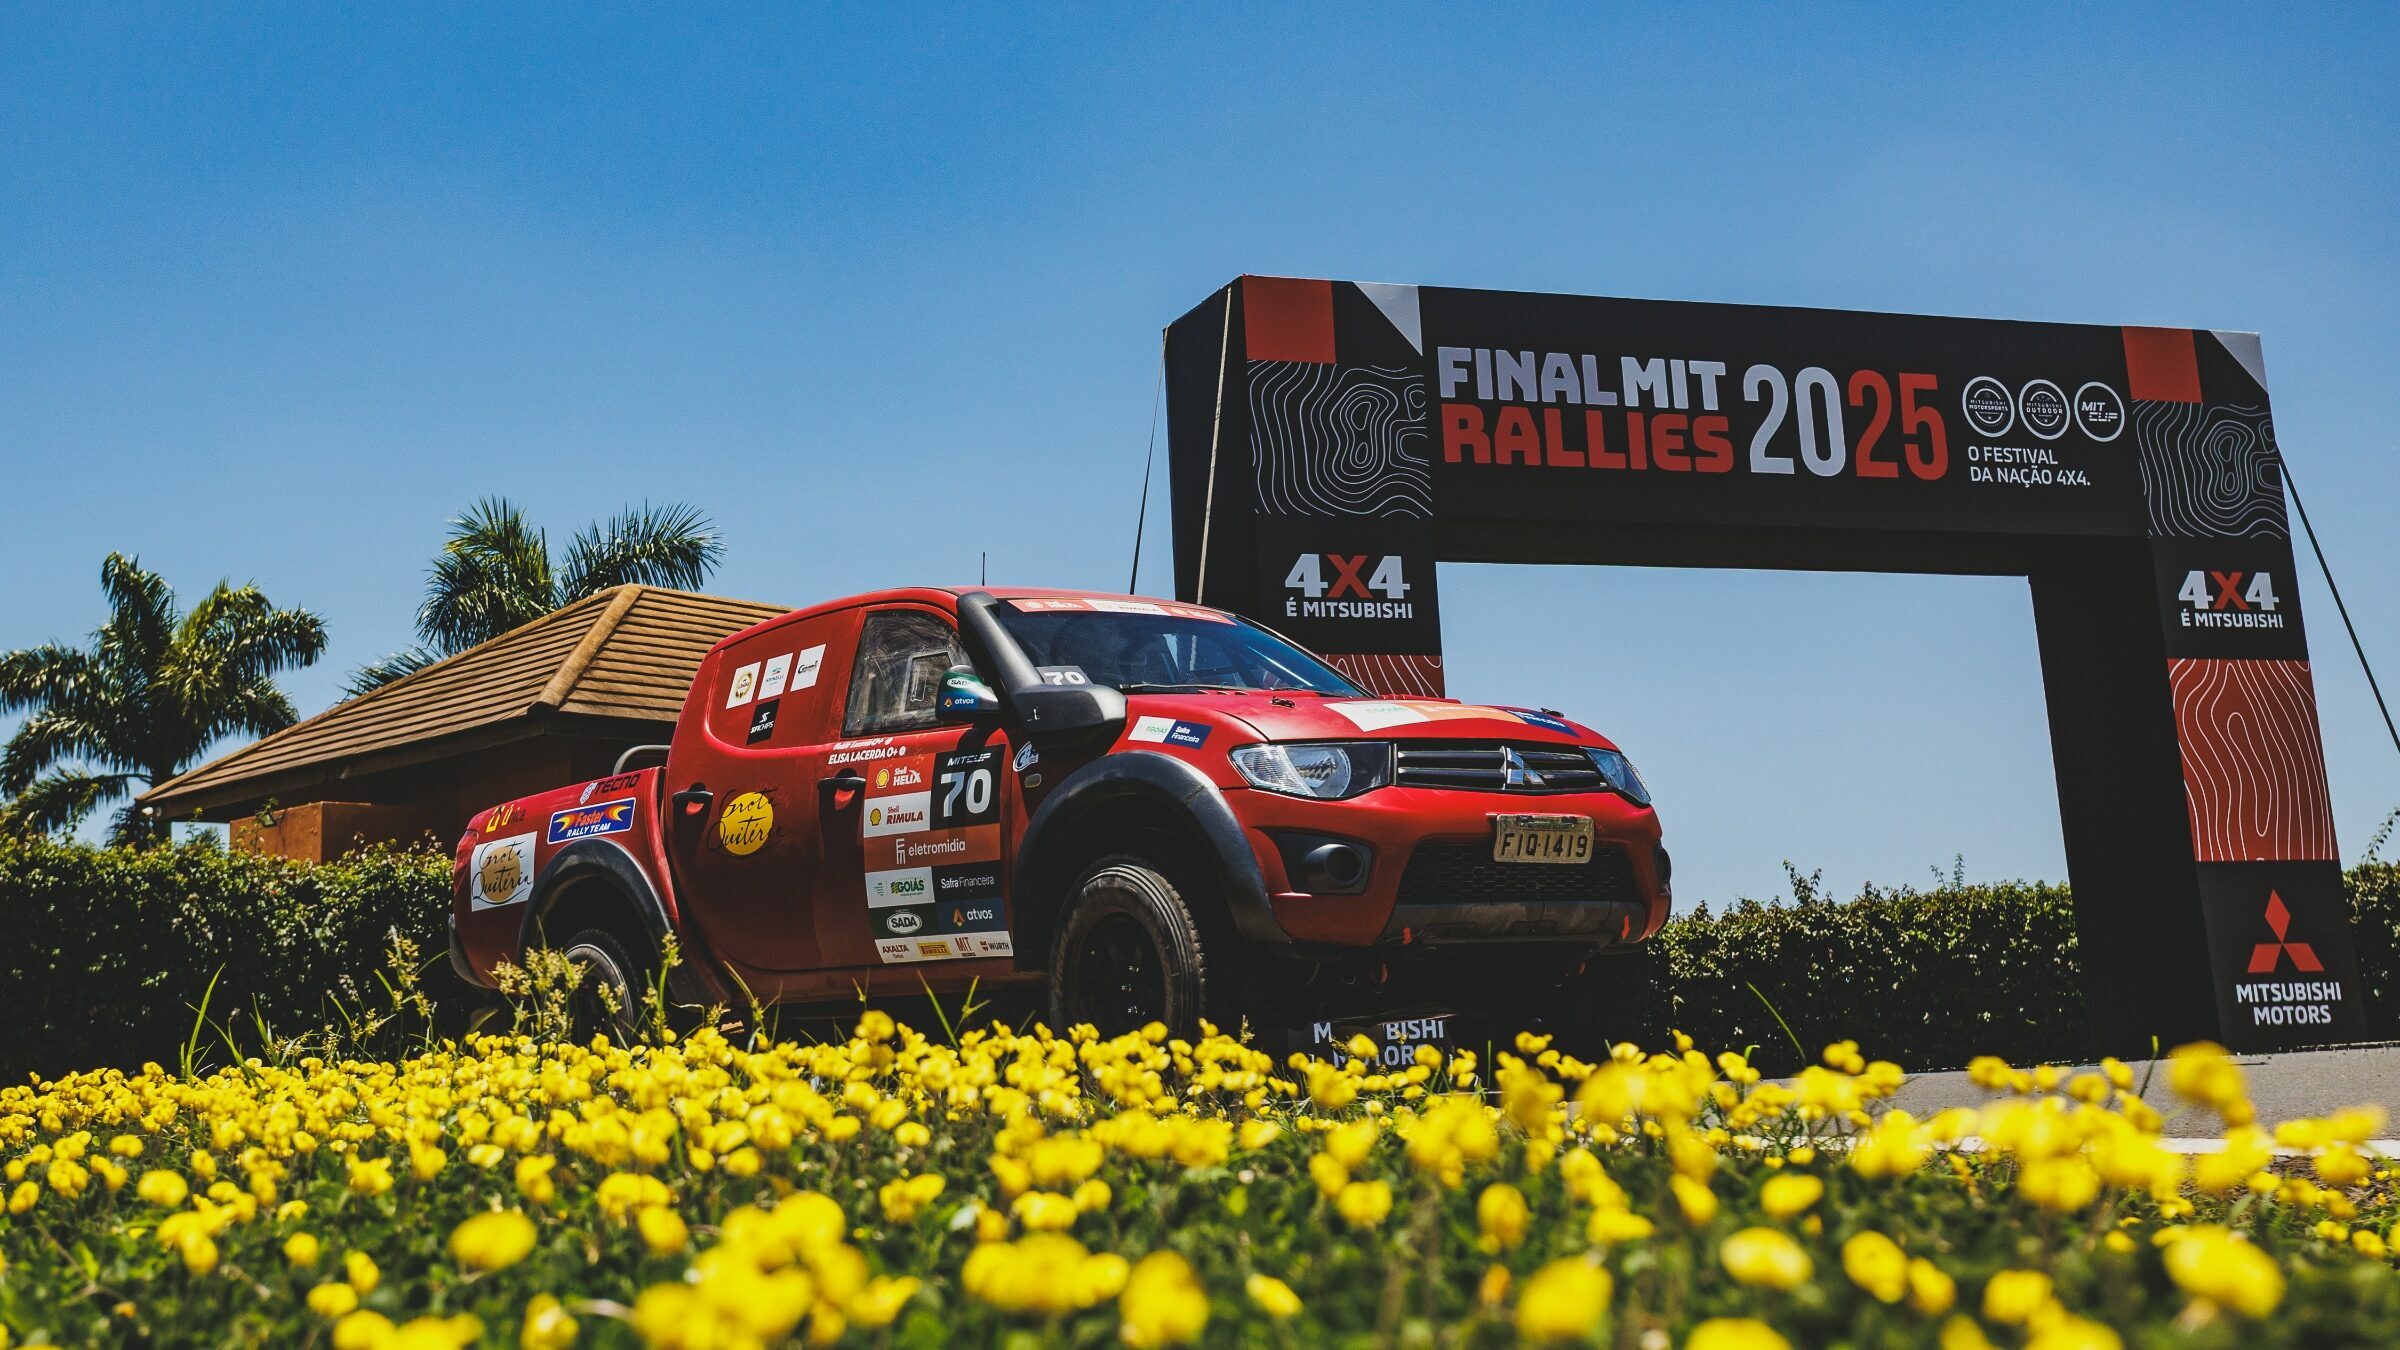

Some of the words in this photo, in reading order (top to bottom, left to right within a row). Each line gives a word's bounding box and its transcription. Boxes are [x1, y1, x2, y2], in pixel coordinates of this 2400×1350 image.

[2081, 401, 2106, 412] MIT
[1742, 363, 1949, 481] 2025
[1441, 403, 1734, 473] RALLIES
[1968, 445, 1979, 461] O
[1983, 446, 2058, 465] FESTIVAL
[1970, 466, 1994, 483] DA
[1997, 464, 2053, 487] NAÇÃO
[1284, 553, 1411, 599] 4X4
[2178, 570, 2280, 611] 4X4
[1286, 597, 1297, 617] É
[1303, 600, 1413, 619] MITSUBISHI
[2180, 608, 2190, 627] É
[2195, 611, 2284, 629] MITSUBISHI
[1043, 671, 1086, 685] 70
[828, 752, 850, 764] ELISA
[850, 748, 886, 762] LACERDA
[893, 769, 922, 787] HELIX
[894, 766, 908, 775] Shell
[940, 768, 992, 818] 70
[886, 811, 924, 825] RIMULA
[887, 804, 899, 814] Shell
[575, 809, 605, 828] Faster
[566, 825, 590, 838] RALLY
[590, 822, 611, 835] TEAM
[908, 838, 966, 857] eletromidia
[898, 878, 925, 893] GOIÁS
[941, 878, 959, 889] Safra
[959, 875, 995, 887] Financeira
[890, 916, 918, 929] SADA
[966, 908, 993, 921] atvos
[882, 944, 910, 954] AXALTA
[920, 944, 948, 955] PIRELLI
[955, 937, 972, 952] MIT
[2235, 981, 2342, 1003] MITSUBISHI
[2253, 1004, 2332, 1026] MOTORS
[1313, 1018, 1444, 1044] MBISHI
